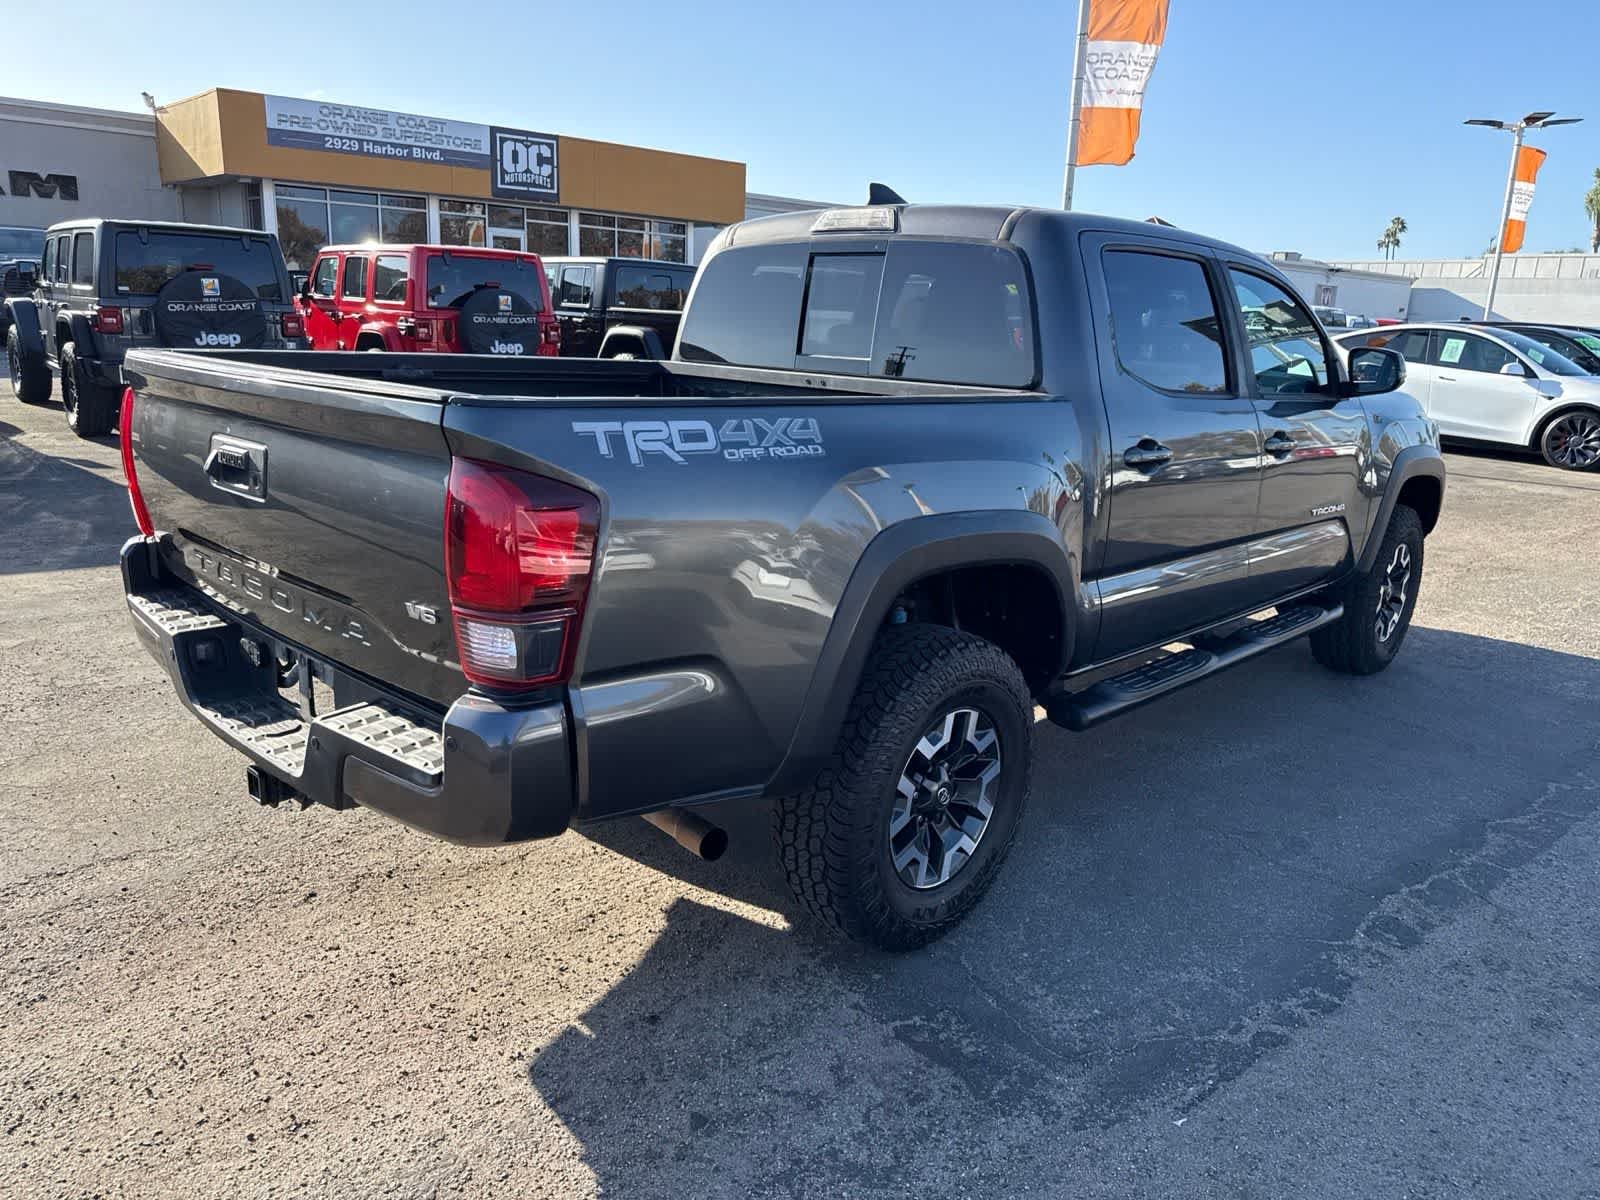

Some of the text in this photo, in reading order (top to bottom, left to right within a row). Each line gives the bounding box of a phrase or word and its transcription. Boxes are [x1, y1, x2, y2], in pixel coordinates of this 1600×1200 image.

[1093, 66, 1145, 81] COAST
[319, 105, 447, 133] ORANGE COAST
[277, 113, 482, 152] PRE-OWNED SUPERSTORE
[324, 136, 444, 161] 2929 Harbor Blvd.
[503, 140, 552, 177] OC
[504, 172, 551, 188] MOTORSPORTS
[167, 302, 257, 311] ORANGE COAST
[472, 315, 537, 324] ORANGE COAST
[194, 330, 241, 348] Jeep
[490, 340, 524, 355] Jeep
[572, 420, 720, 467] TRD
[723, 444, 824, 462] OFF ROAD
[1311, 503, 1345, 517] TACOMA
[404, 600, 441, 625] V6
